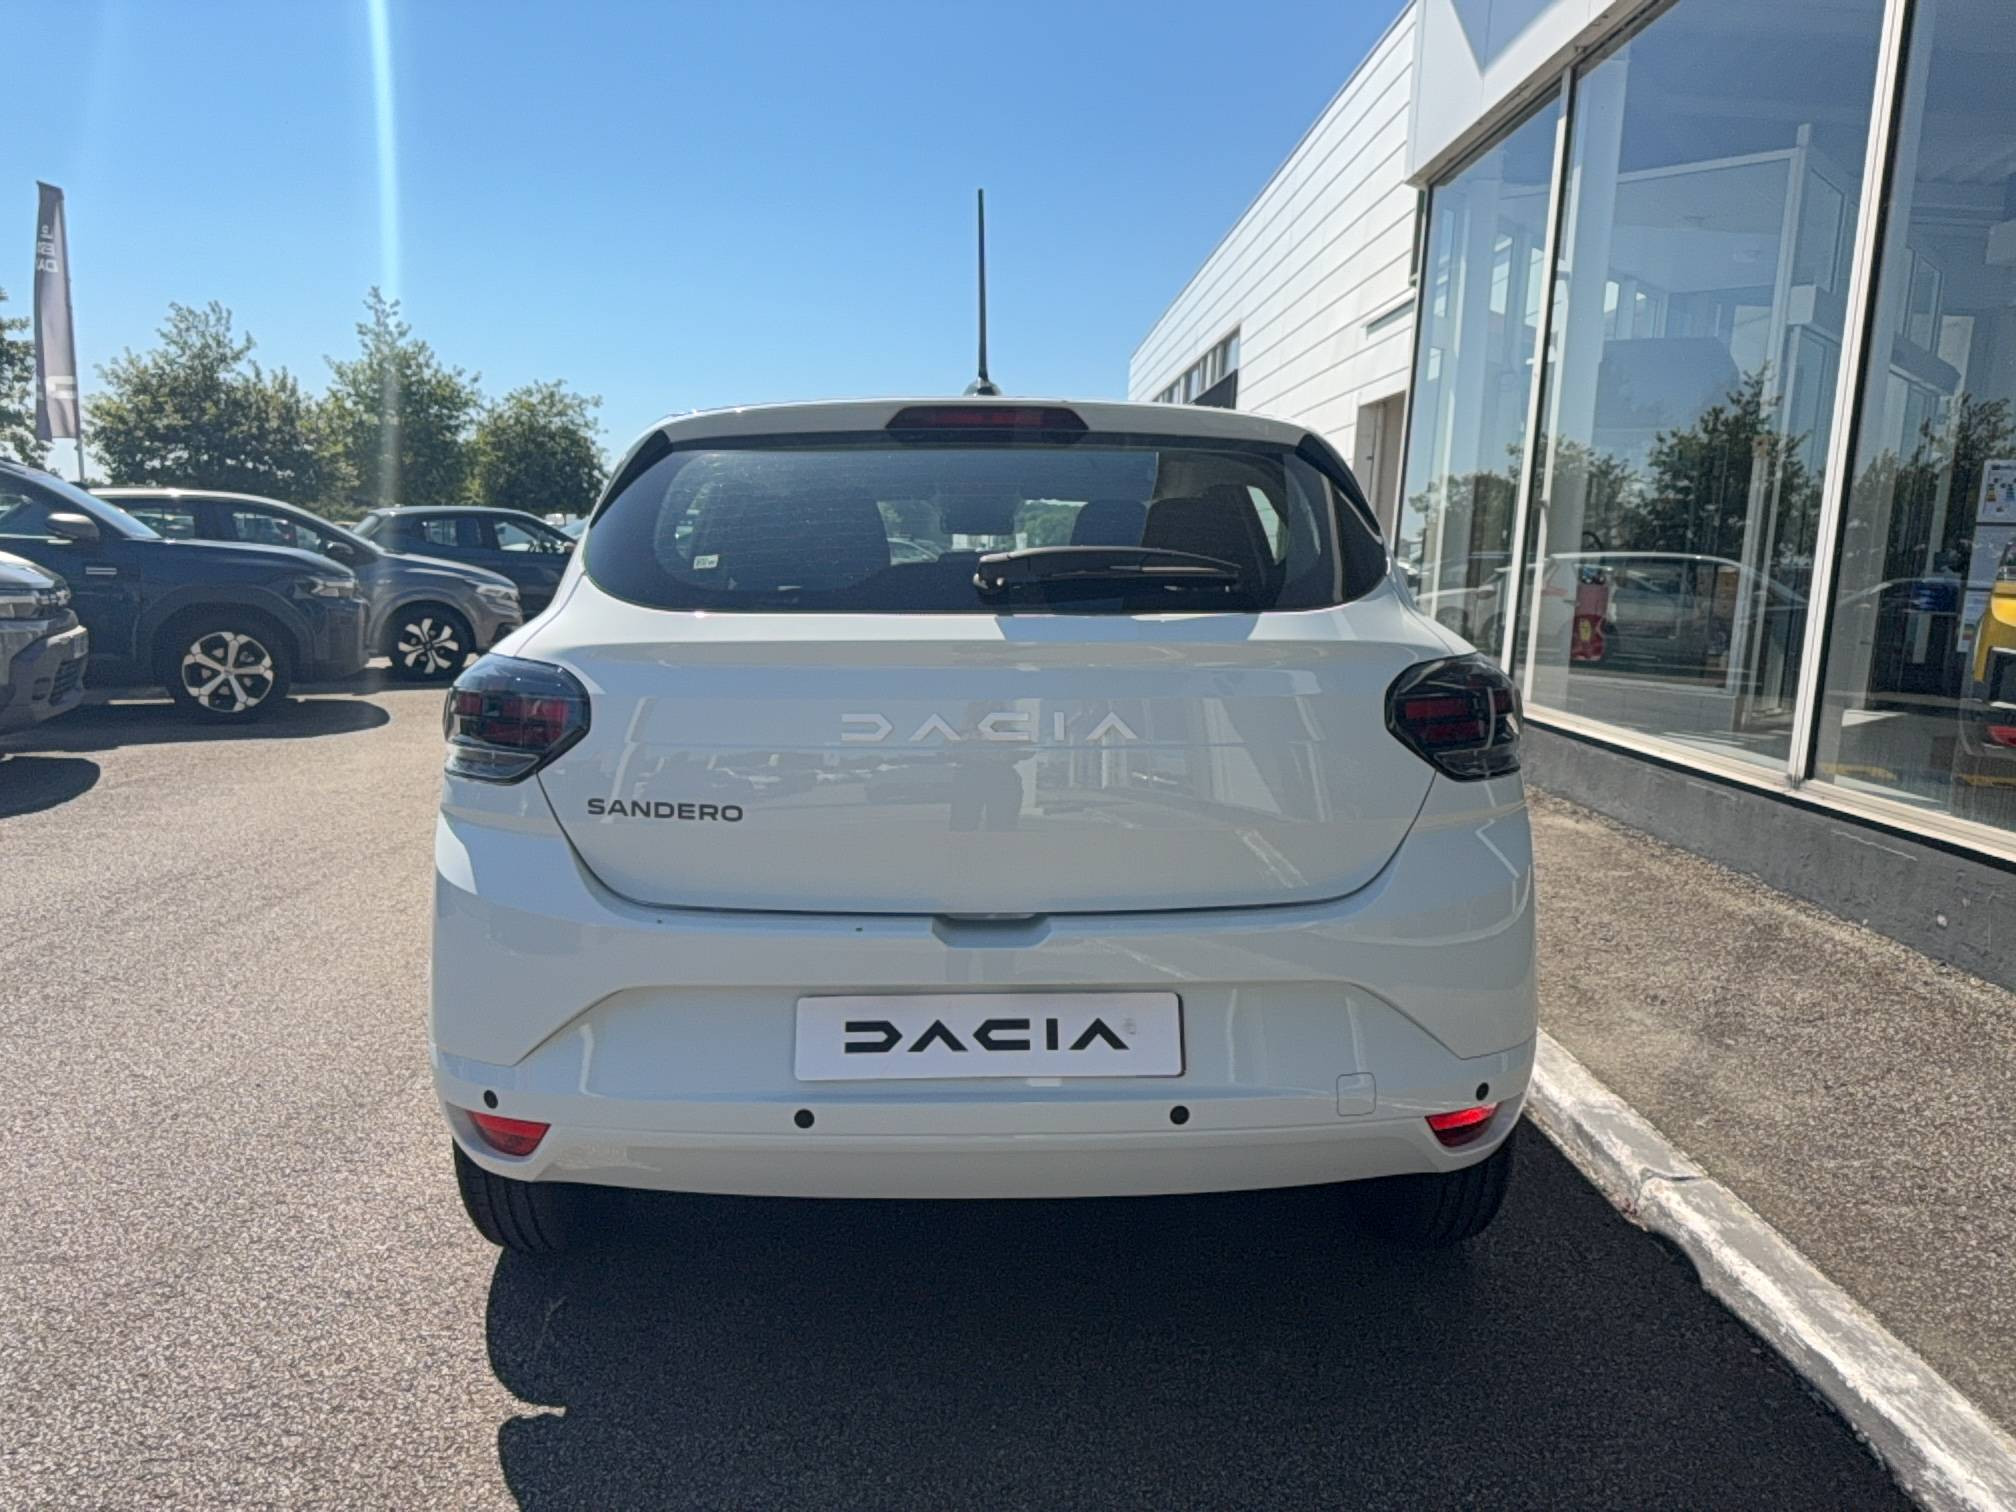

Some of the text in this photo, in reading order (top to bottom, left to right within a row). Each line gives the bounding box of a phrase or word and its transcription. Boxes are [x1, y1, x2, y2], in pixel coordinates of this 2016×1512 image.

[841, 711, 1137, 741] DACIA
[587, 798, 744, 822] SANDERO
[844, 1018, 1130, 1053] DACIA
